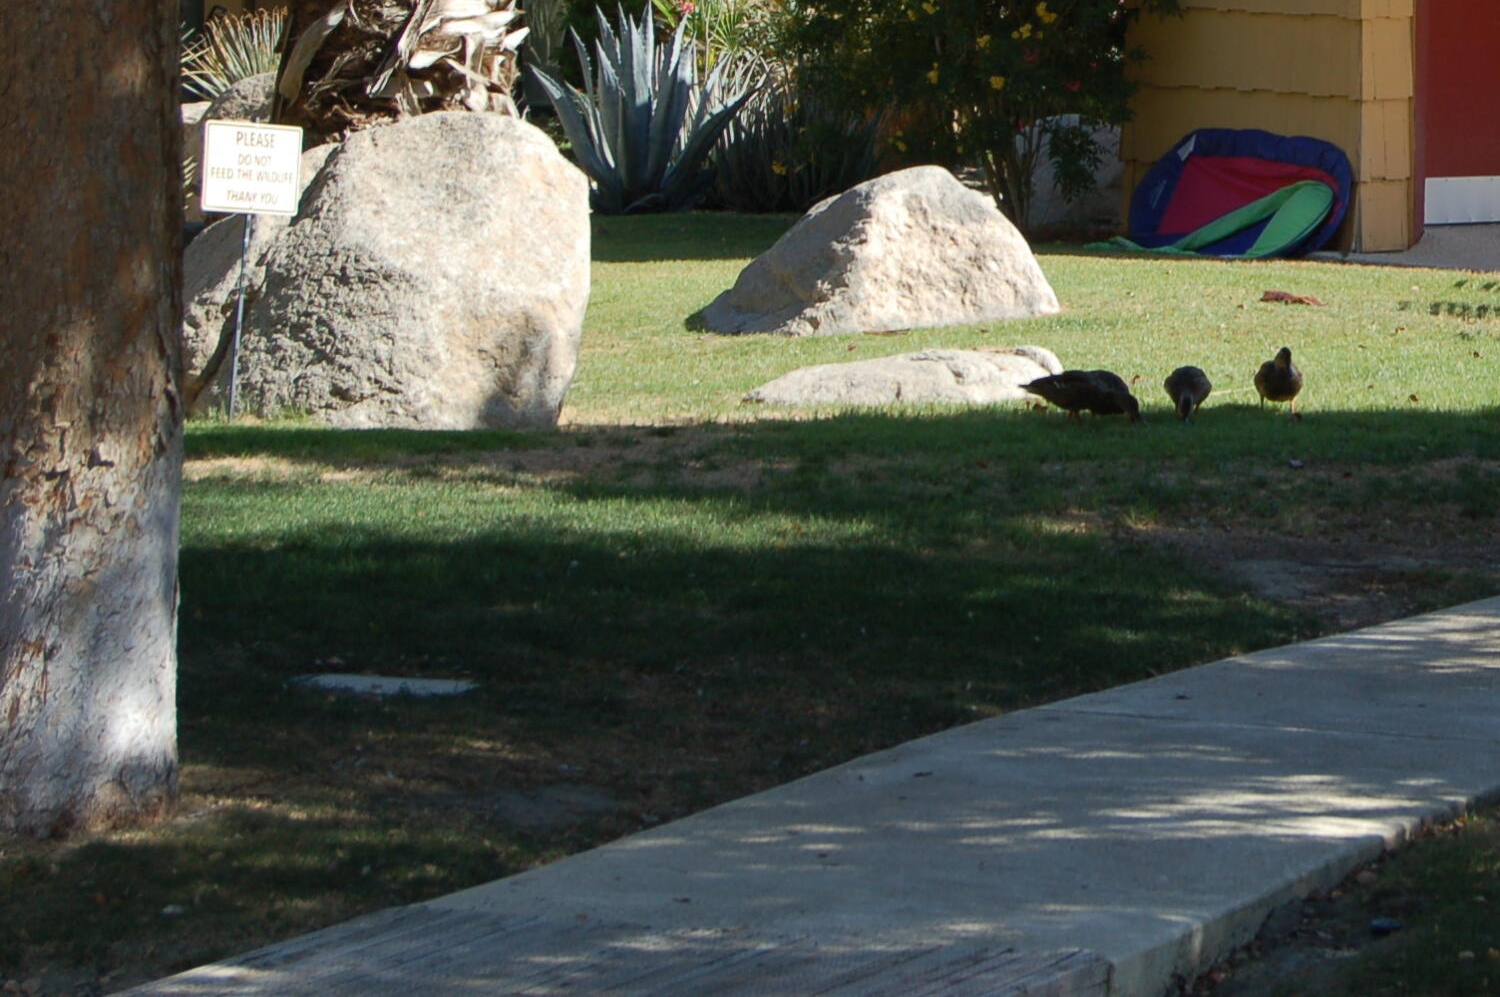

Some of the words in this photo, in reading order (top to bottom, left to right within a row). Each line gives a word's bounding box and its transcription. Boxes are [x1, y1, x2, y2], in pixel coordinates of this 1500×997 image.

[236, 131, 275, 148] PLEASE
[238, 154, 252, 165] DO
[254, 155, 272, 166] NOT
[210, 167, 234, 179] FEED
[237, 168, 253, 181] THE
[256, 171, 293, 184] WILDLIFE
[227, 190, 257, 202] THANK
[260, 193, 278, 205] YOU
